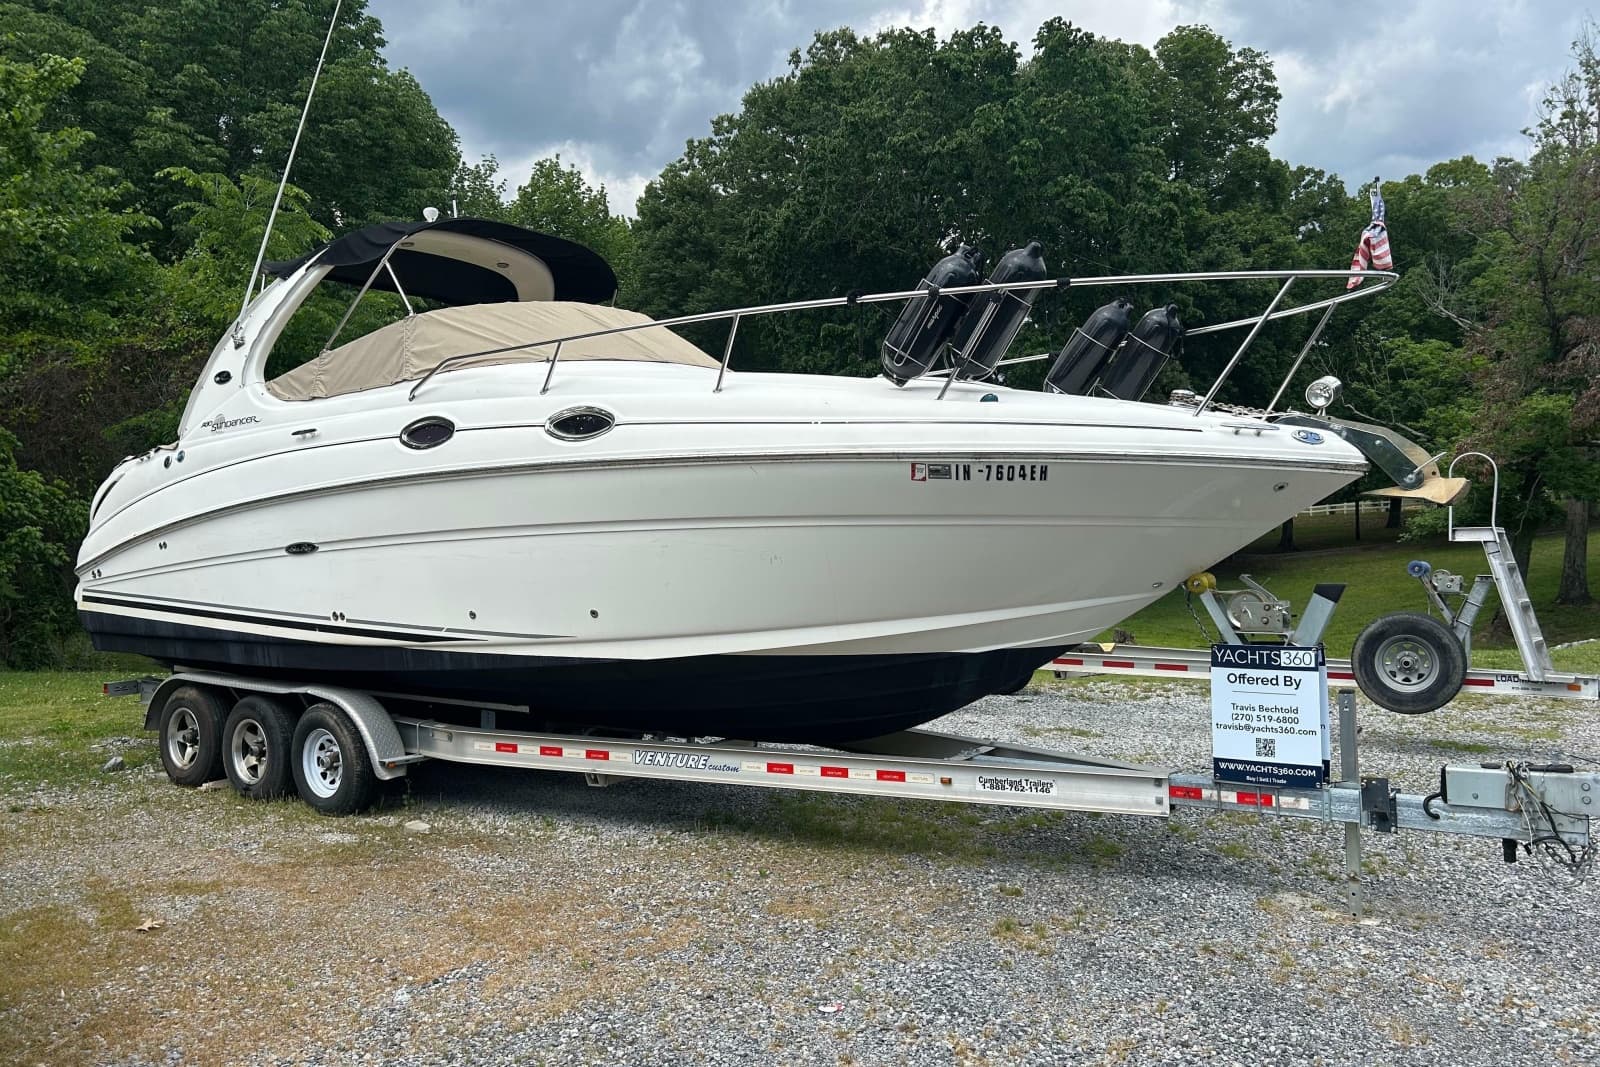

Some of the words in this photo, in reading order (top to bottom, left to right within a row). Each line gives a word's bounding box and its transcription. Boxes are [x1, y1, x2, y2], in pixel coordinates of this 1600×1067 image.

[1227, 673, 1279, 687] Offered
[1283, 675, 1302, 690] By
[1231, 703, 1256, 712] Travis
[1258, 704, 1299, 714] Bechtold
[1231, 713, 1254, 723] (270)
[1256, 714, 1300, 724] 519-6800
[1216, 722, 1317, 736] travisb@yachts360.com
[635, 749, 710, 769] VENTURE
[707, 764, 740, 773] custom
[1218, 762, 1316, 777] WWW.YACHTS360.COM
[978, 775, 1023, 786] Cumberland
